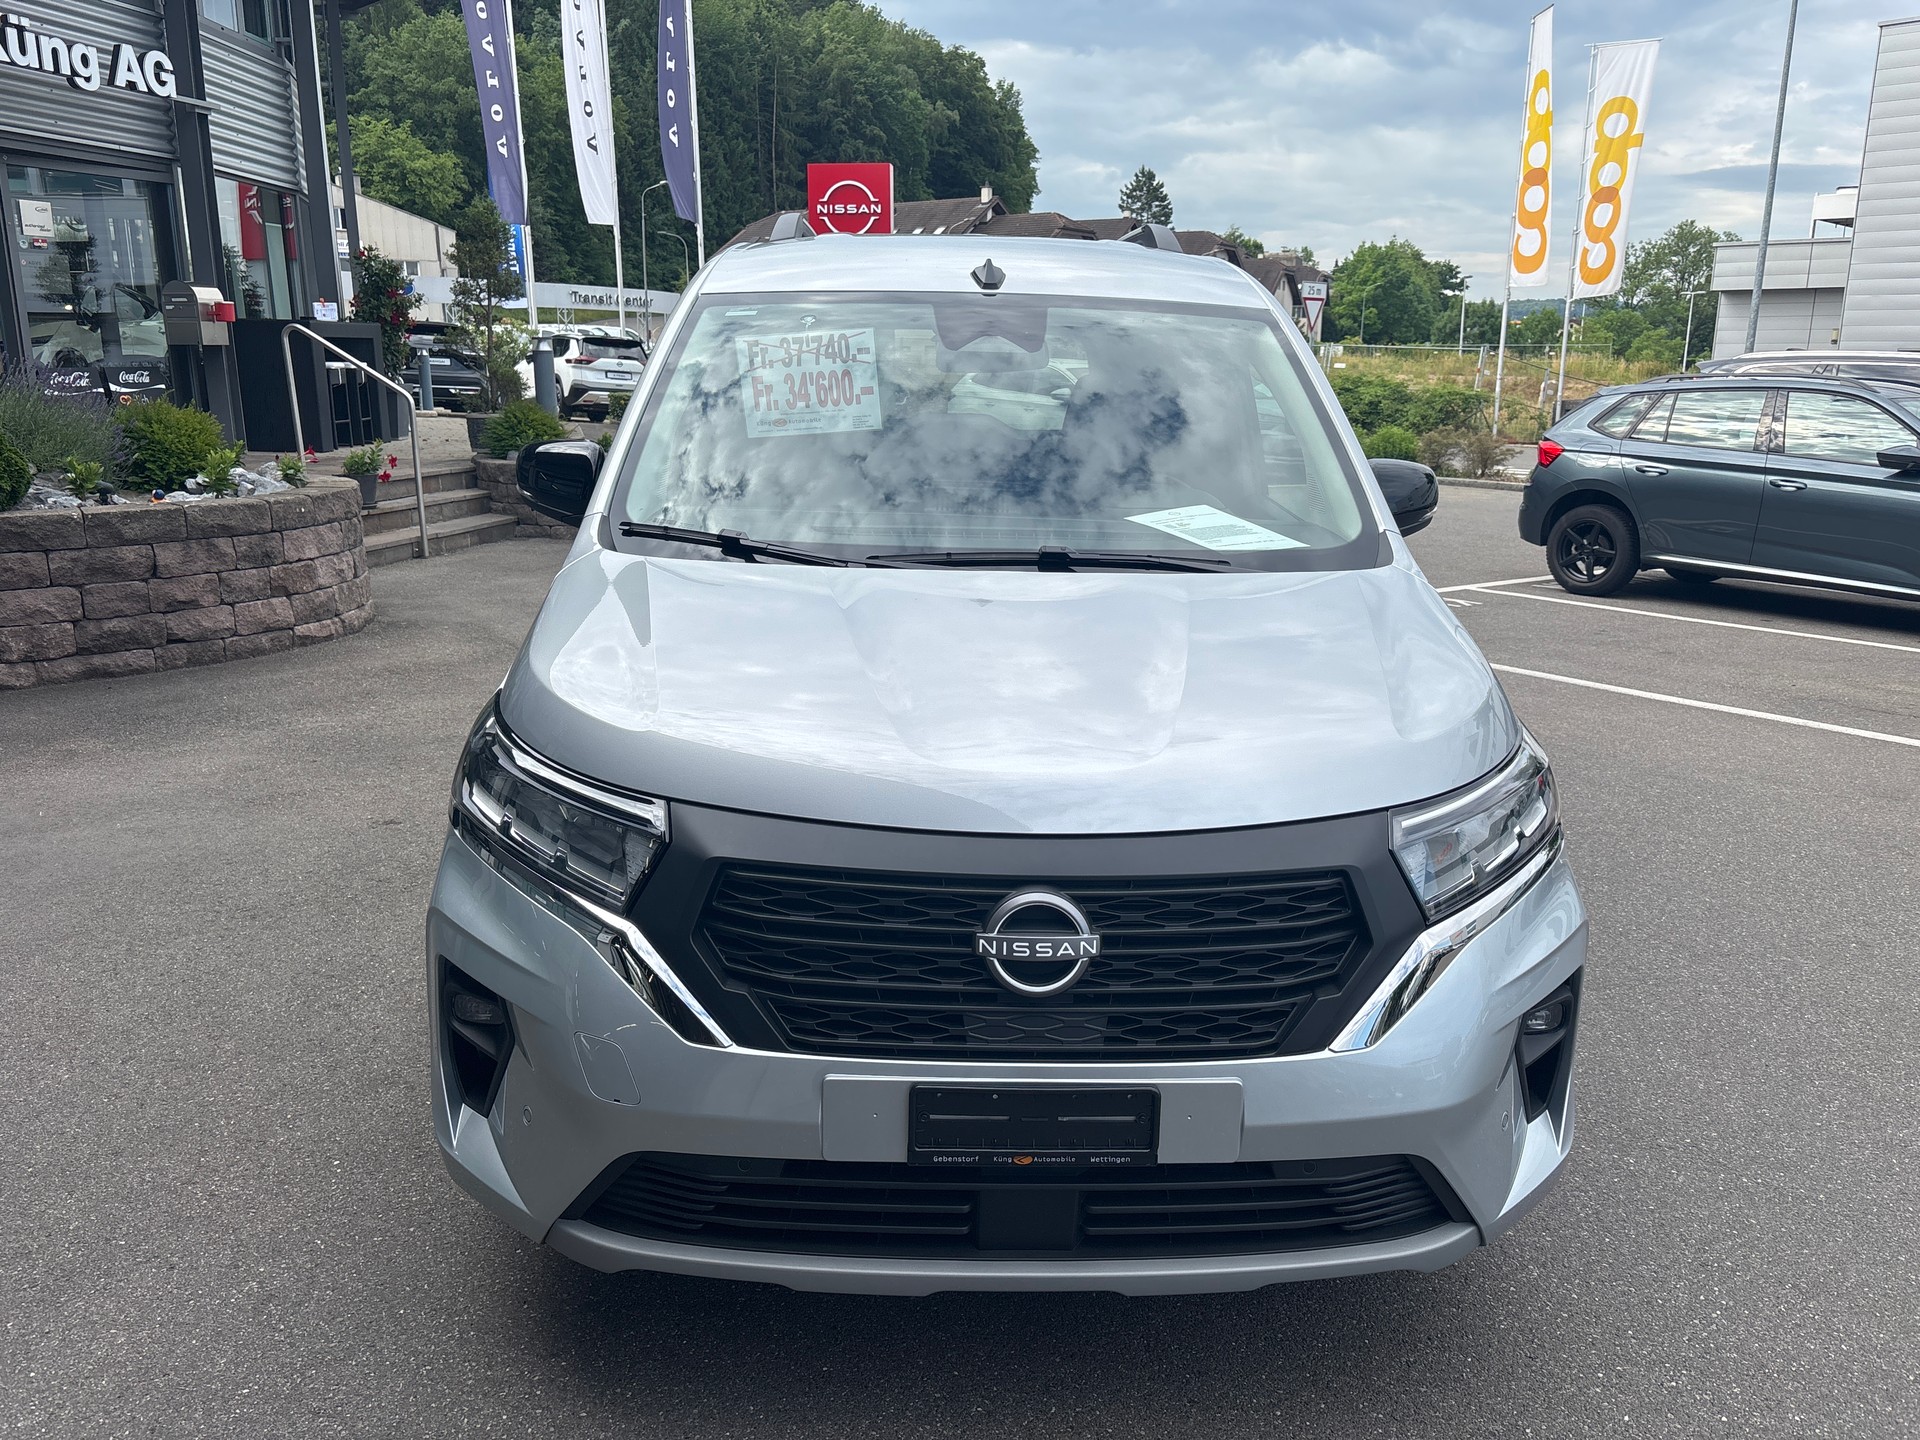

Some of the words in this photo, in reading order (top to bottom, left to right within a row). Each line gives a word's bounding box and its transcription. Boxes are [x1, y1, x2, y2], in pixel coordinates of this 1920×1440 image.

[0, 13, 100, 92] üng
[113, 43, 177, 98] AG
[1579, 96, 1644, 285] coop
[816, 204, 882, 214] NISSAN
[571, 290, 613, 305] Transit
[1307, 285, 1315, 296] 25
[752, 375, 780, 412] Fr.
[978, 938, 1098, 957] NISSAN
[933, 1155, 979, 1163] Gebenstorf
[993, 1155, 1012, 1164] Küng
[1033, 1155, 1076, 1163] Automobile
[1090, 1155, 1131, 1164] Wettingen
